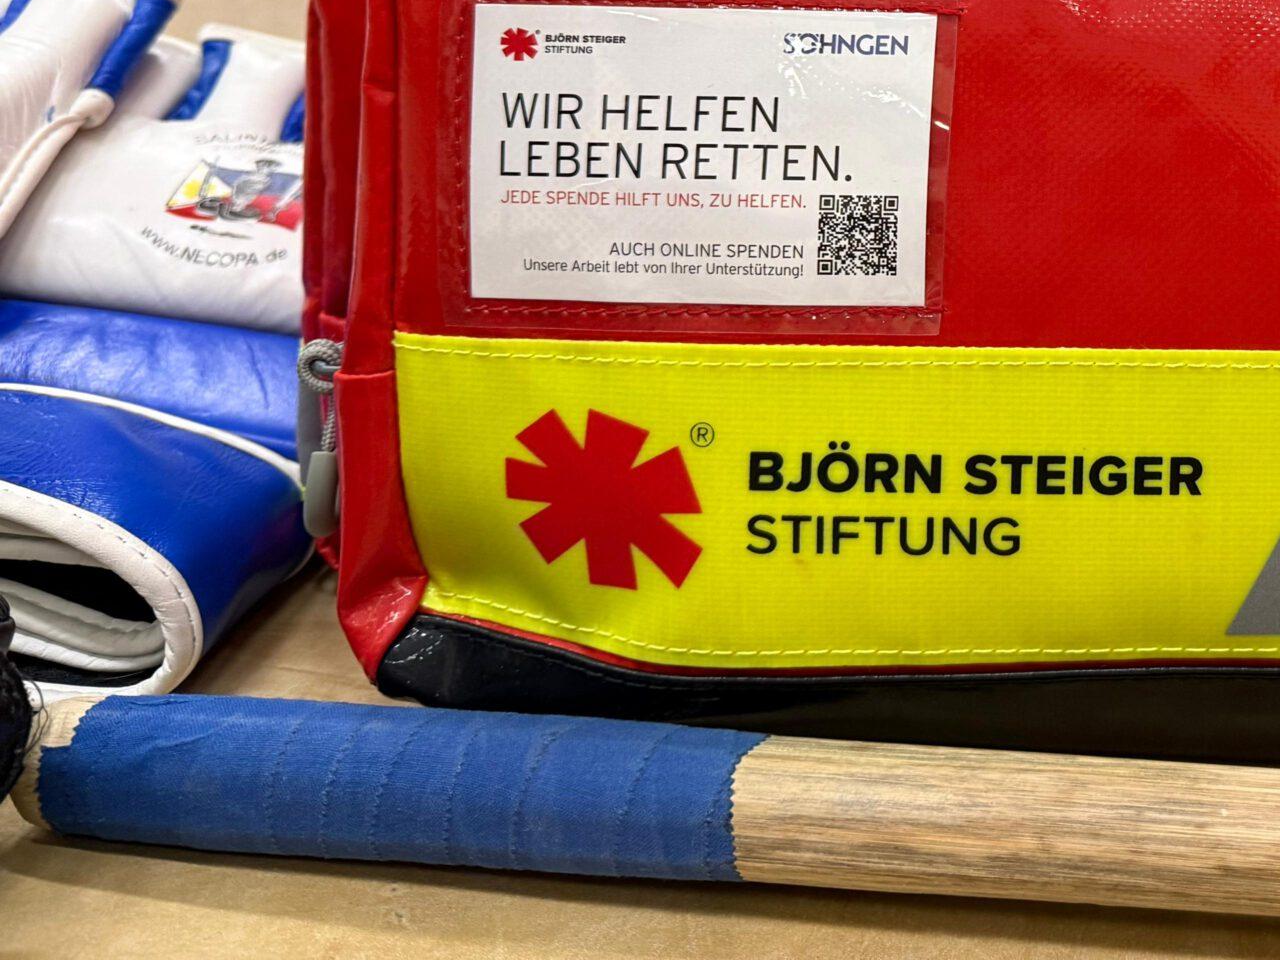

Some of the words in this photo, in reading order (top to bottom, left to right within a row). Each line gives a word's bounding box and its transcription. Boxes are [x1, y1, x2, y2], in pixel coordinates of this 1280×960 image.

[545, 32, 580, 44] BJÖRN
[582, 34, 627, 45] STEIGER
[544, 44, 594, 55] STIFTUNG
[502, 92, 583, 130] WIR
[602, 94, 779, 133] HELFEN
[499, 140, 643, 179] LEBEN
[662, 143, 853, 182] RETTEN.
[500, 190, 541, 205] JEDE
[546, 191, 610, 207] SPENDE
[615, 192, 662, 207] HILFT
[666, 193, 705, 209] UNS,
[709, 194, 733, 208] ZU
[738, 194, 807, 209] HELFEN.
[609, 242, 655, 257] AUCH
[660, 243, 722, 258] ONLINE
[726, 244, 804, 259] SPENDEN
[523, 259, 568, 272] Unsere
[571, 259, 611, 273] Arbeit
[614, 261, 640, 274] lebt
[643, 264, 667, 274] von
[671, 262, 703, 275] Ihrer
[706, 263, 804, 279] Unterstützung!
[748, 440, 943, 494] BJÖRN
[963, 454, 1204, 497] STEIGER
[746, 514, 1022, 557] STIFTUNG
